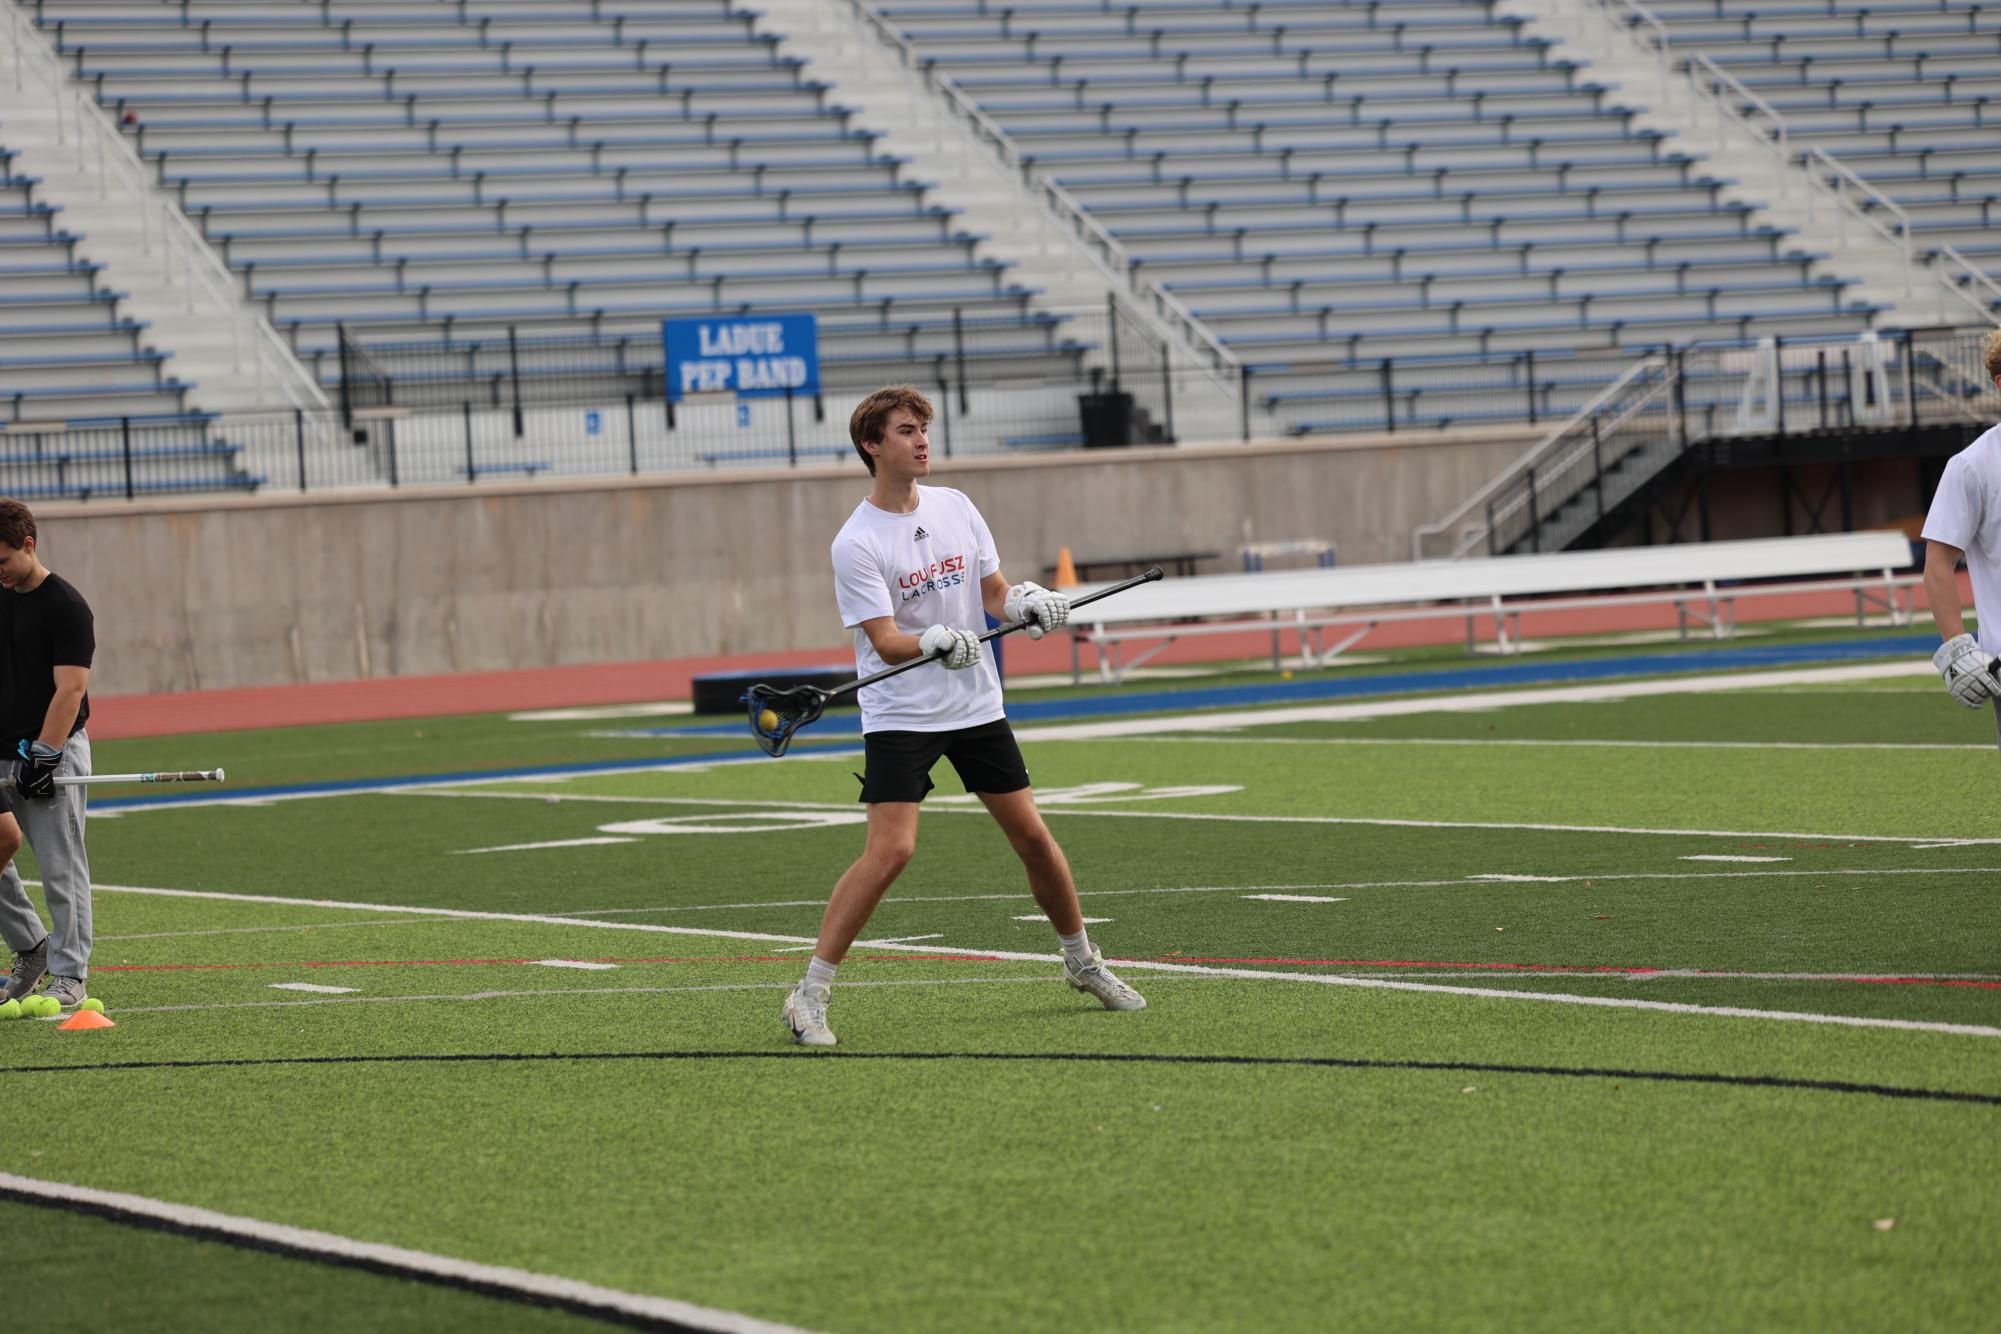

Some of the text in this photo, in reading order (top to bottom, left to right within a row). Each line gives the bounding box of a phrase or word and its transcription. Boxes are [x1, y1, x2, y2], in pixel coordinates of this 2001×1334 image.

[699, 323, 784, 356] LADUE
[680, 356, 807, 392] PEP BAND
[899, 567, 929, 589] LOU
